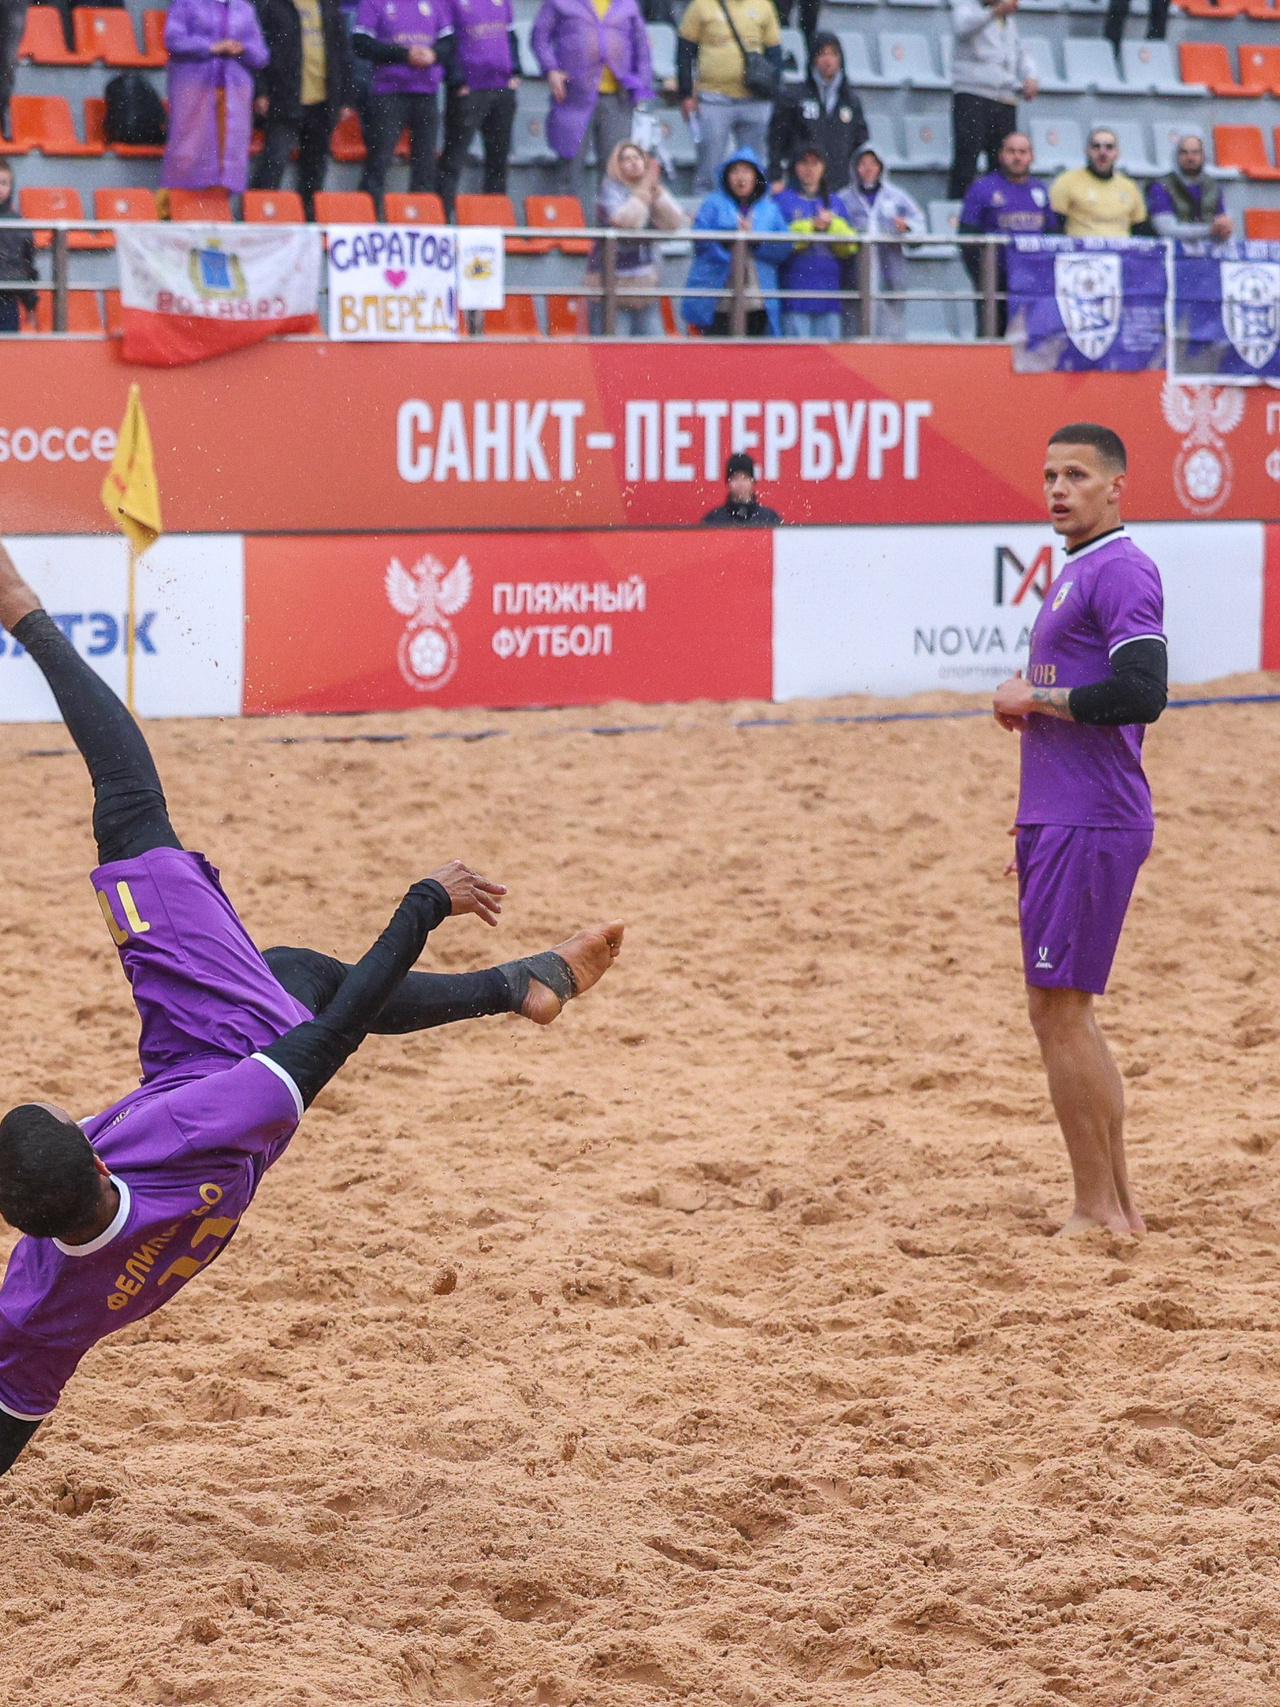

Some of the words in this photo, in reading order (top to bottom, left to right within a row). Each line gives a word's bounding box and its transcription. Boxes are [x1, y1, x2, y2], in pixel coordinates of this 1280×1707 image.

[330, 231, 454, 272] САРАТОВ
[492, 573, 647, 616] ПЛЯЖНЫЙ
[491, 622, 613, 660] ФУТБОЛ
[914, 626, 1005, 655] NOVA
[97, 880, 151, 946] 11
[106, 1182, 223, 1311] ФЕЛИПЬО
